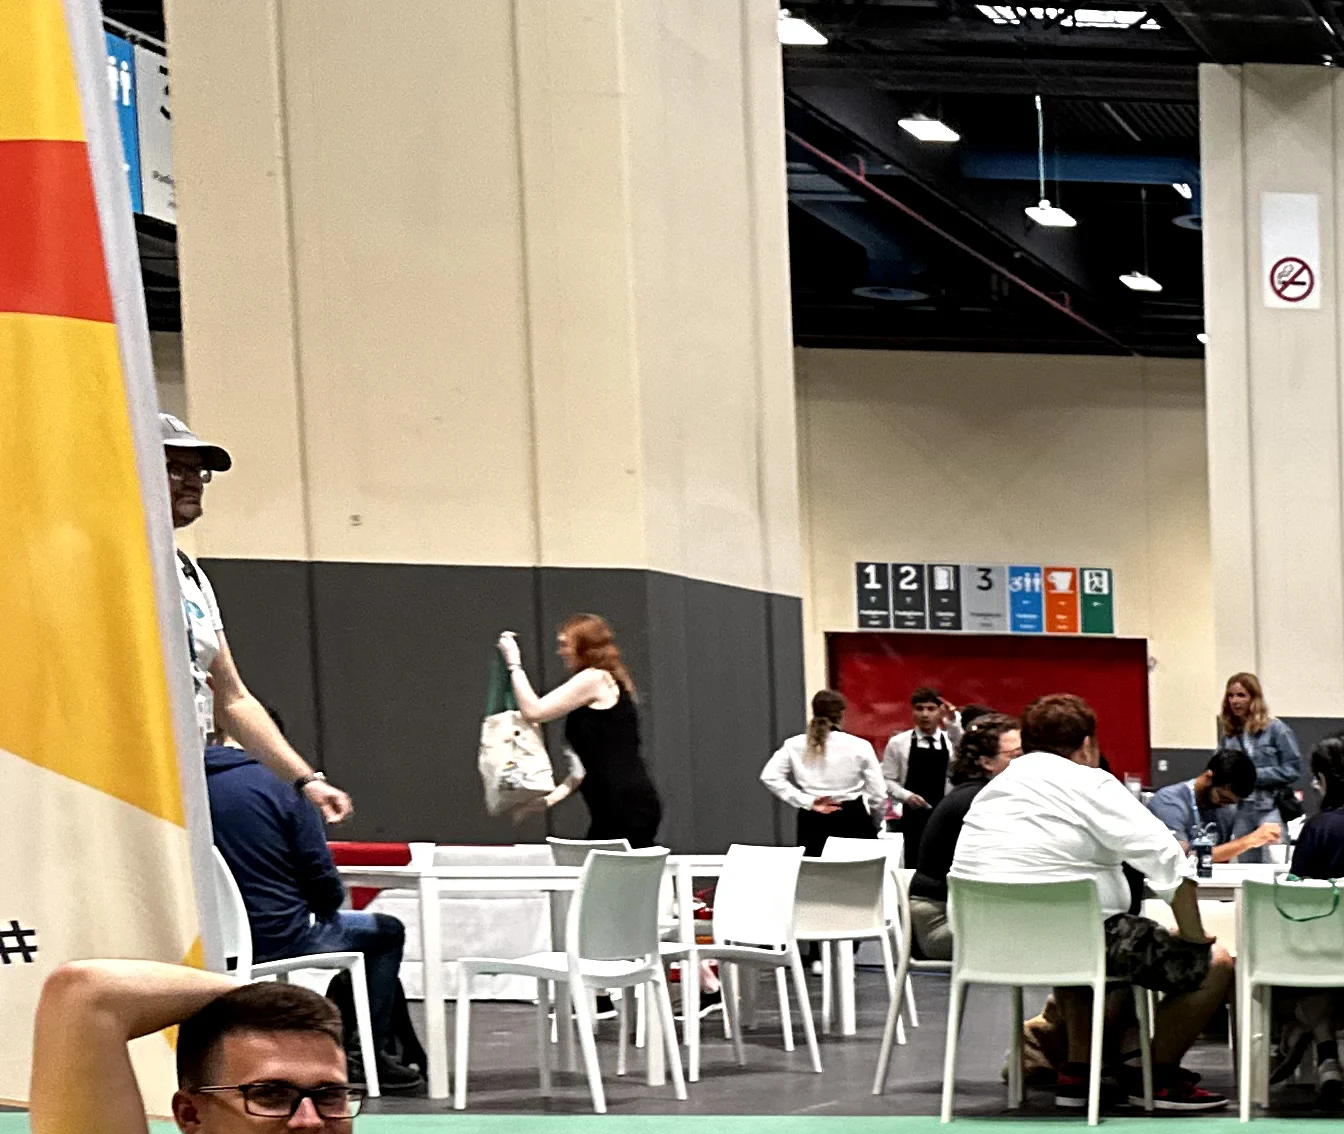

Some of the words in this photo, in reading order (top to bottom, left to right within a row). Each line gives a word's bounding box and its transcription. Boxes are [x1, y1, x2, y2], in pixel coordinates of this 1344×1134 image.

[863, 564, 883, 590] 1
[899, 565, 919, 591] 2
[976, 567, 993, 591] 3
